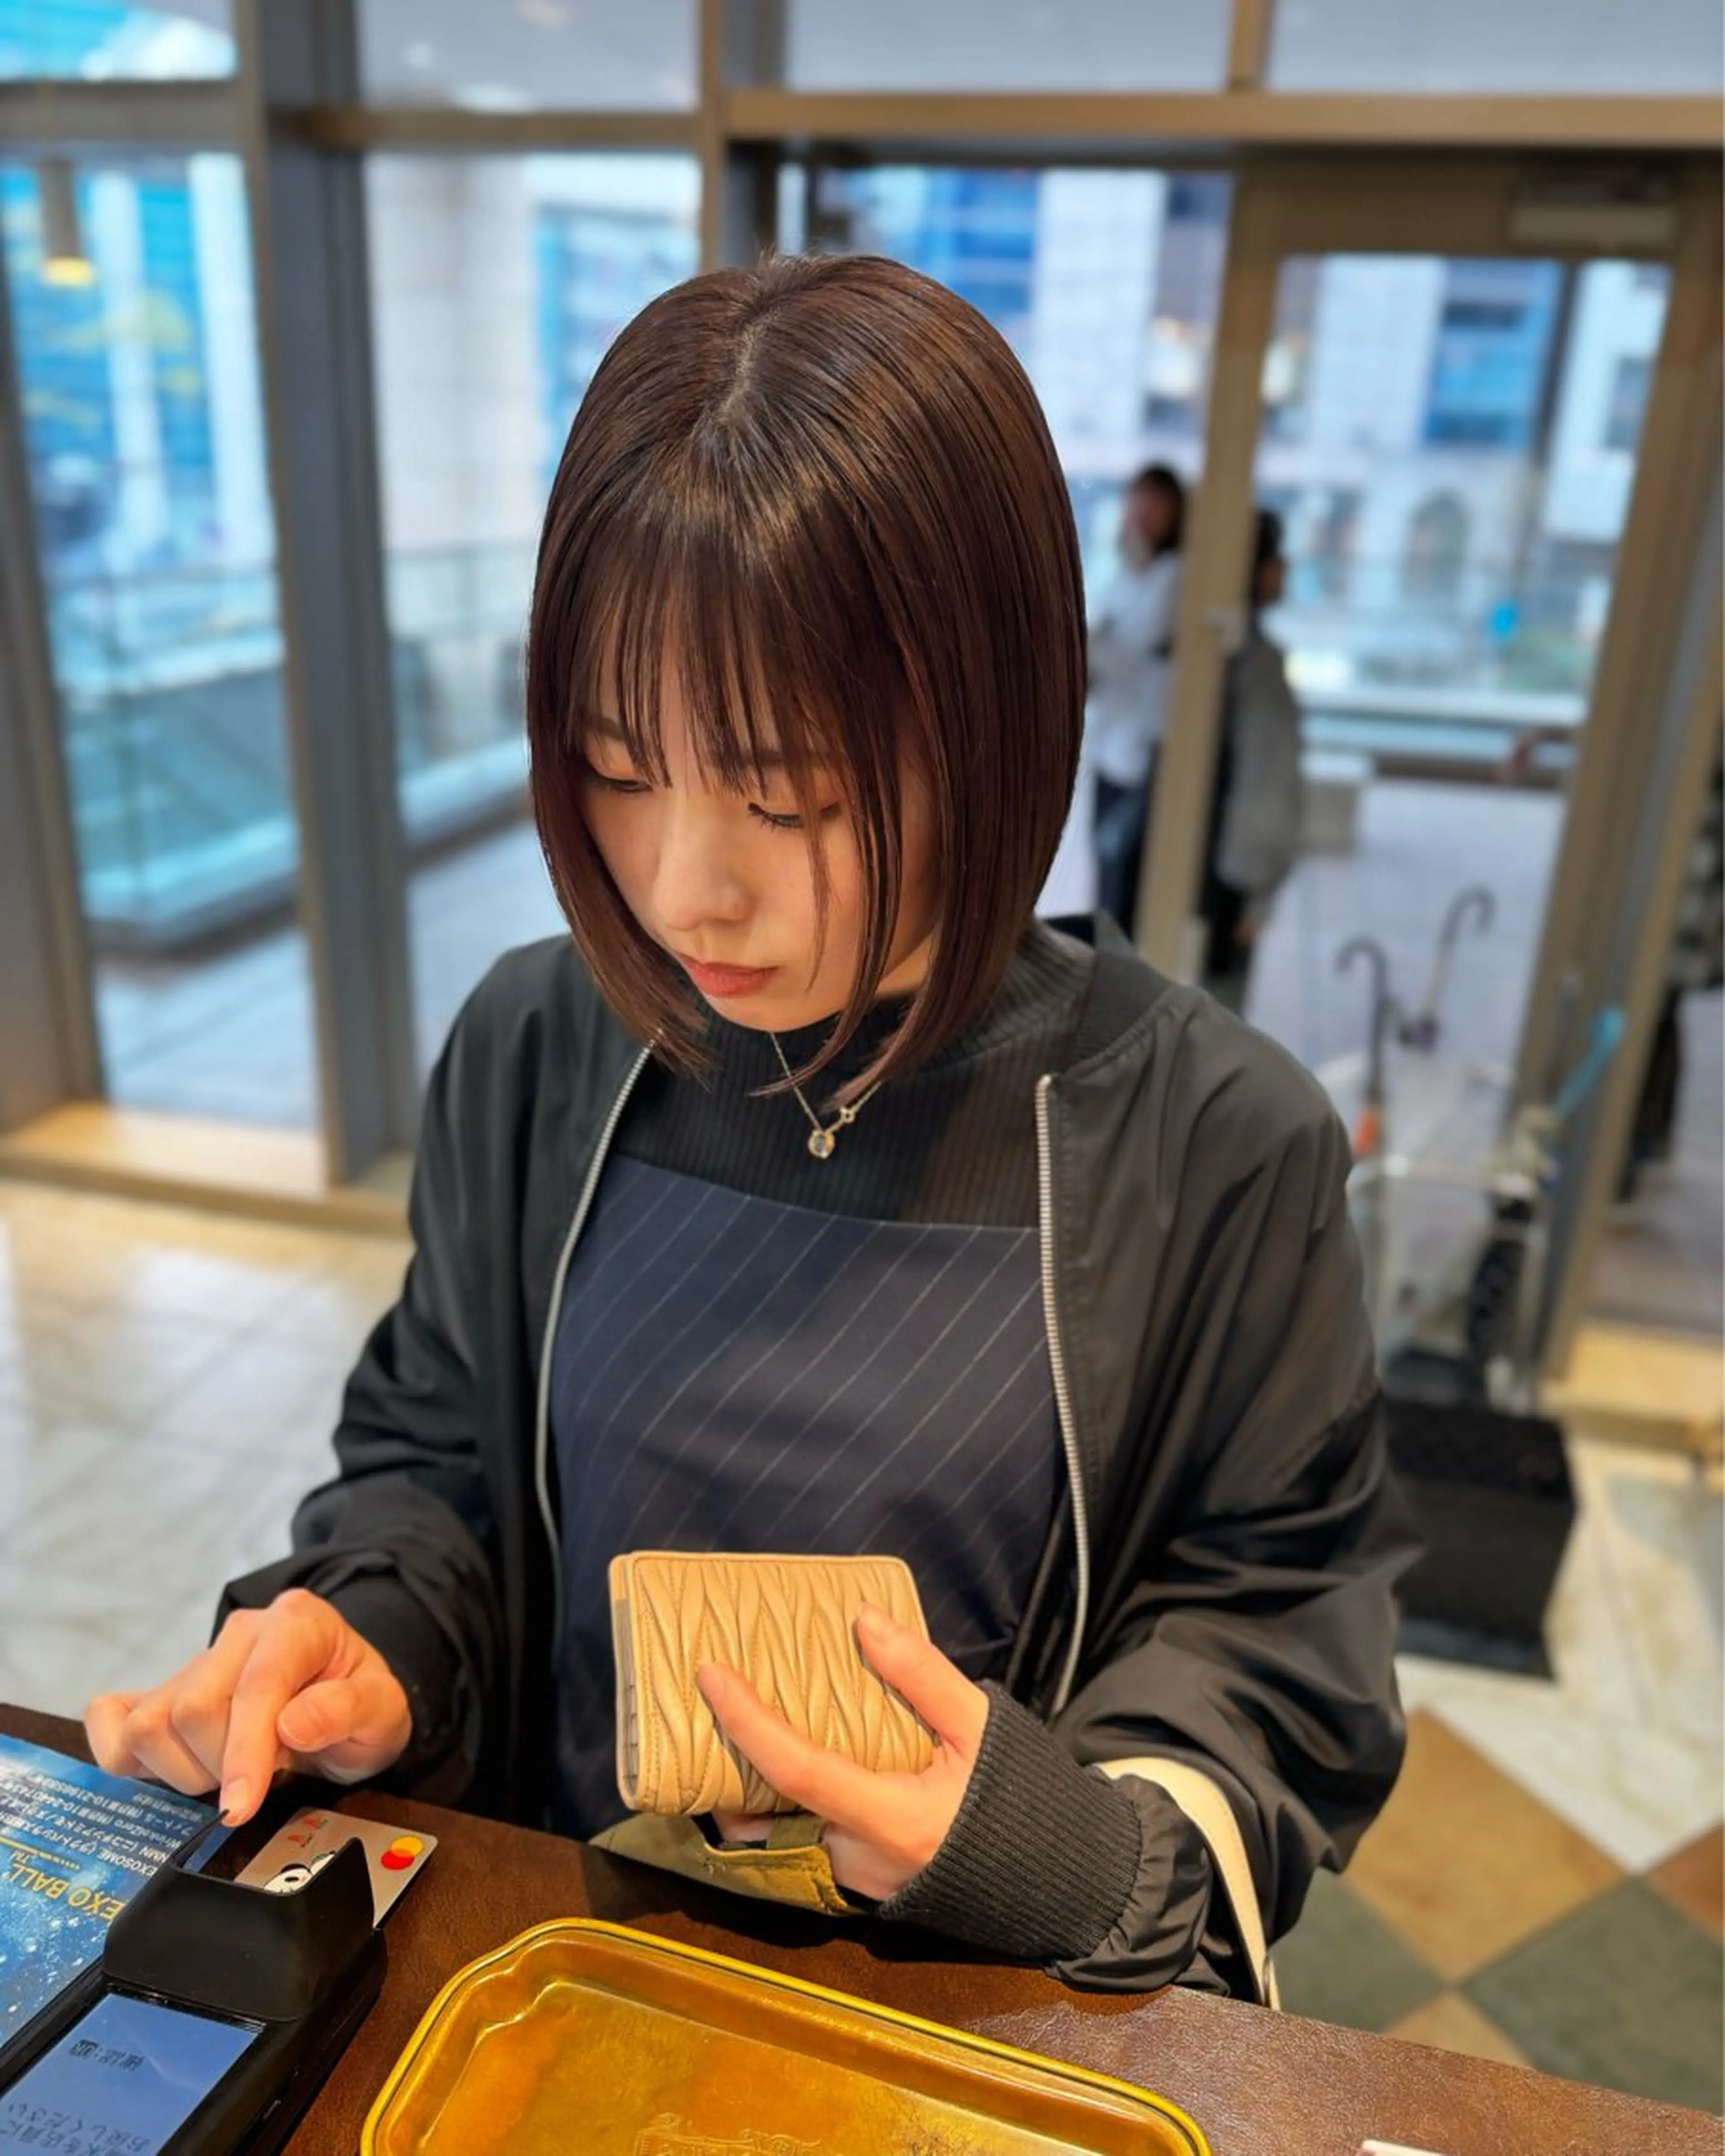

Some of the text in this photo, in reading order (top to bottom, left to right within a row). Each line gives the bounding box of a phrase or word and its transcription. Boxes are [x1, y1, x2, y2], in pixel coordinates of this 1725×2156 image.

[98, 1850, 157, 1876] EXOSOME
[138, 1846, 169, 1863] NMN
[10, 1864, 125, 1921] EXO BALL
